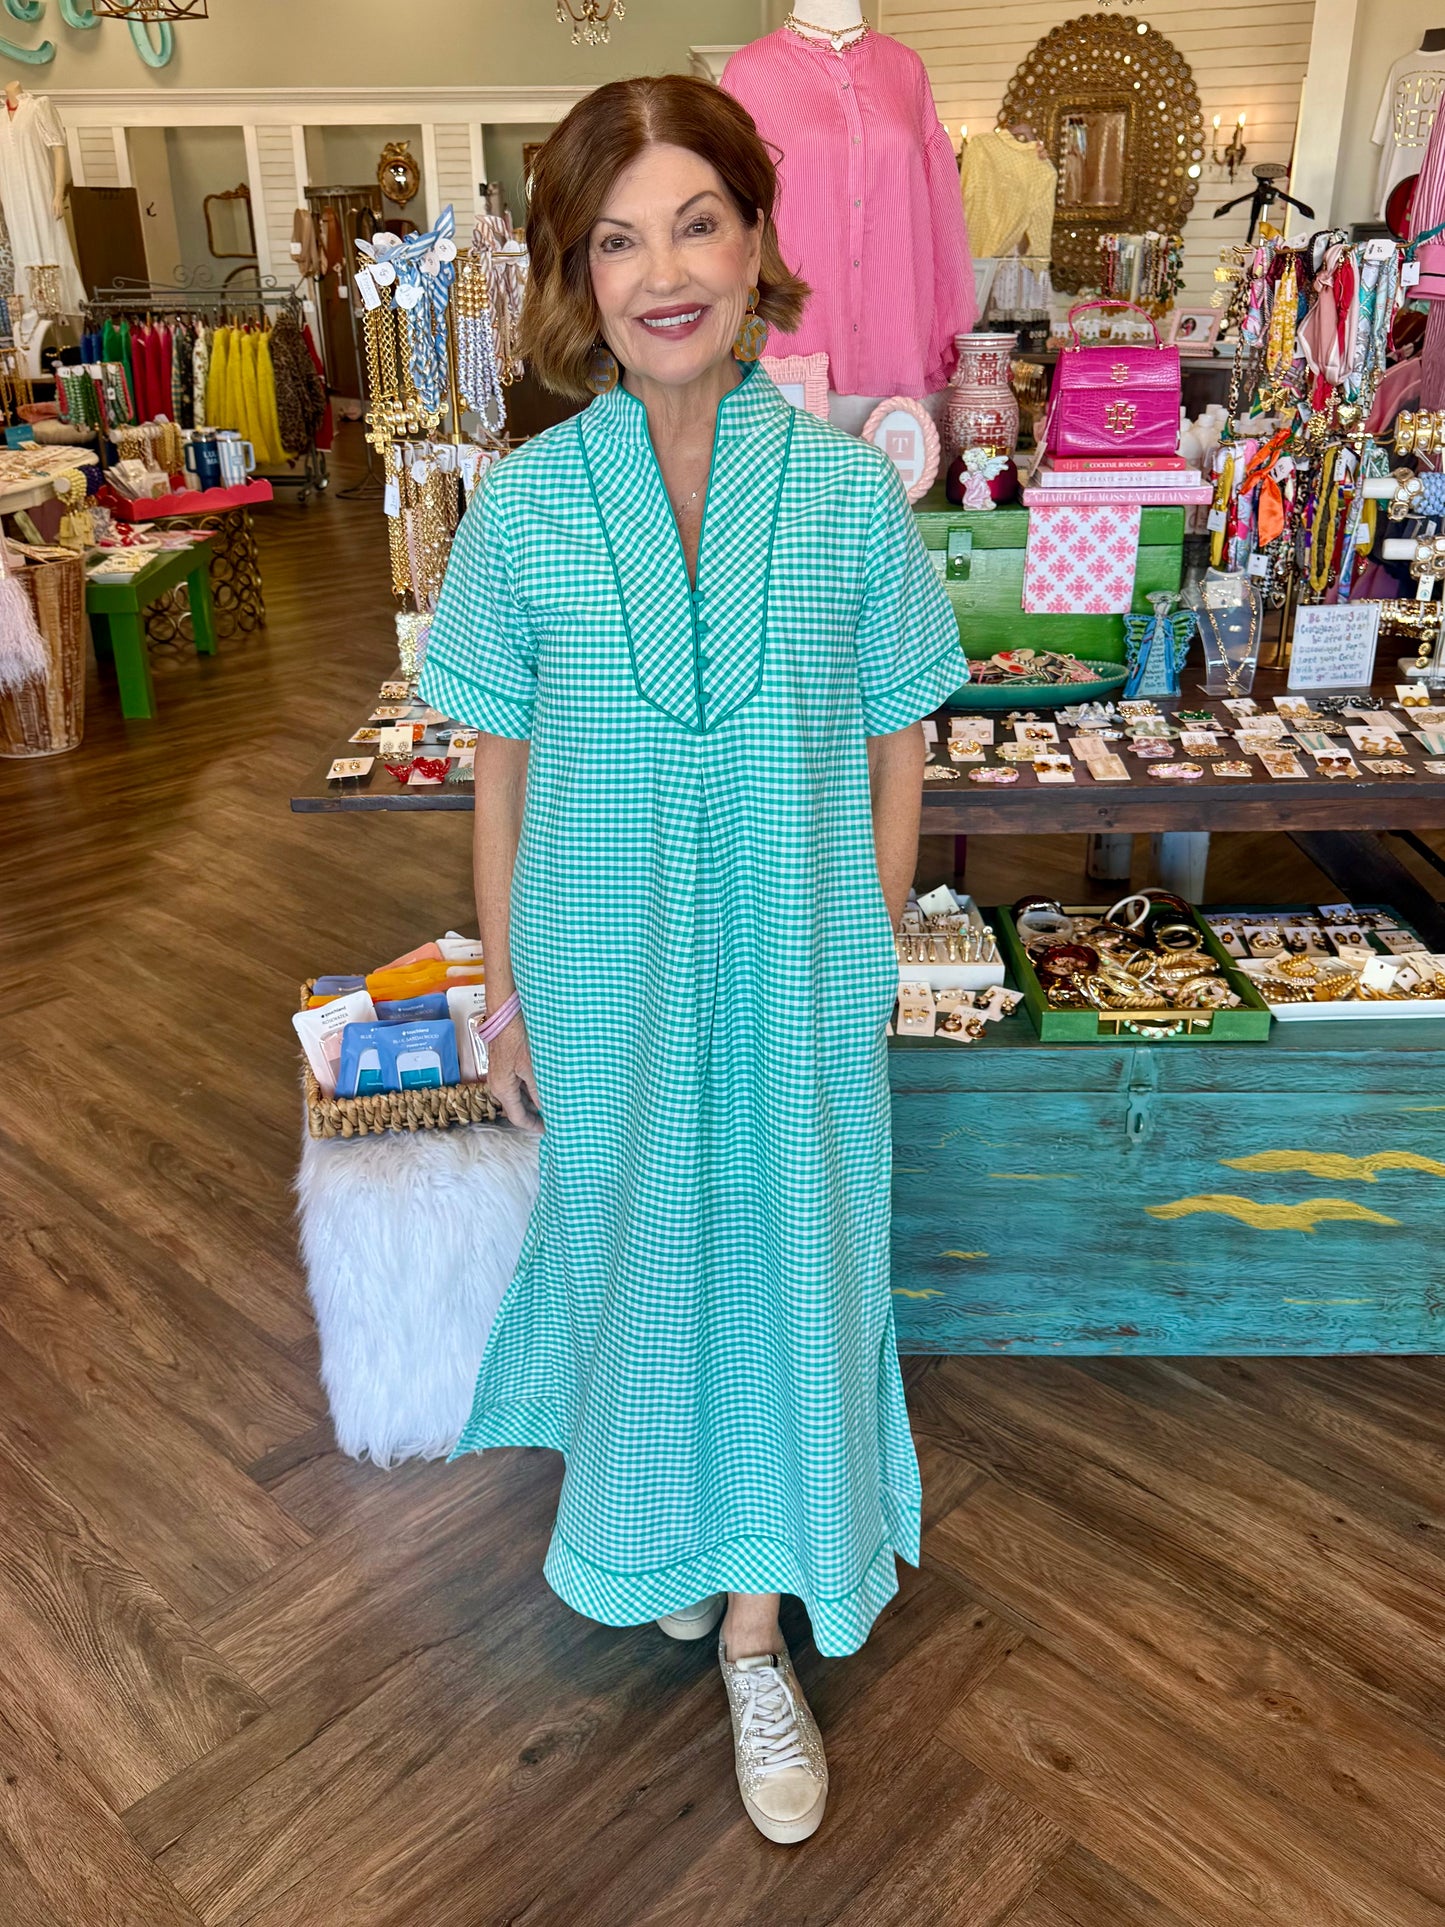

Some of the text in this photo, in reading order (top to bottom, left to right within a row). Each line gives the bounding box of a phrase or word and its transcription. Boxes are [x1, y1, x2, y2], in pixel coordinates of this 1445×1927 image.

[892, 437, 909, 453] T
[1033, 490, 1191, 503] CHARLOTTE MOSS ENTERTAINS
